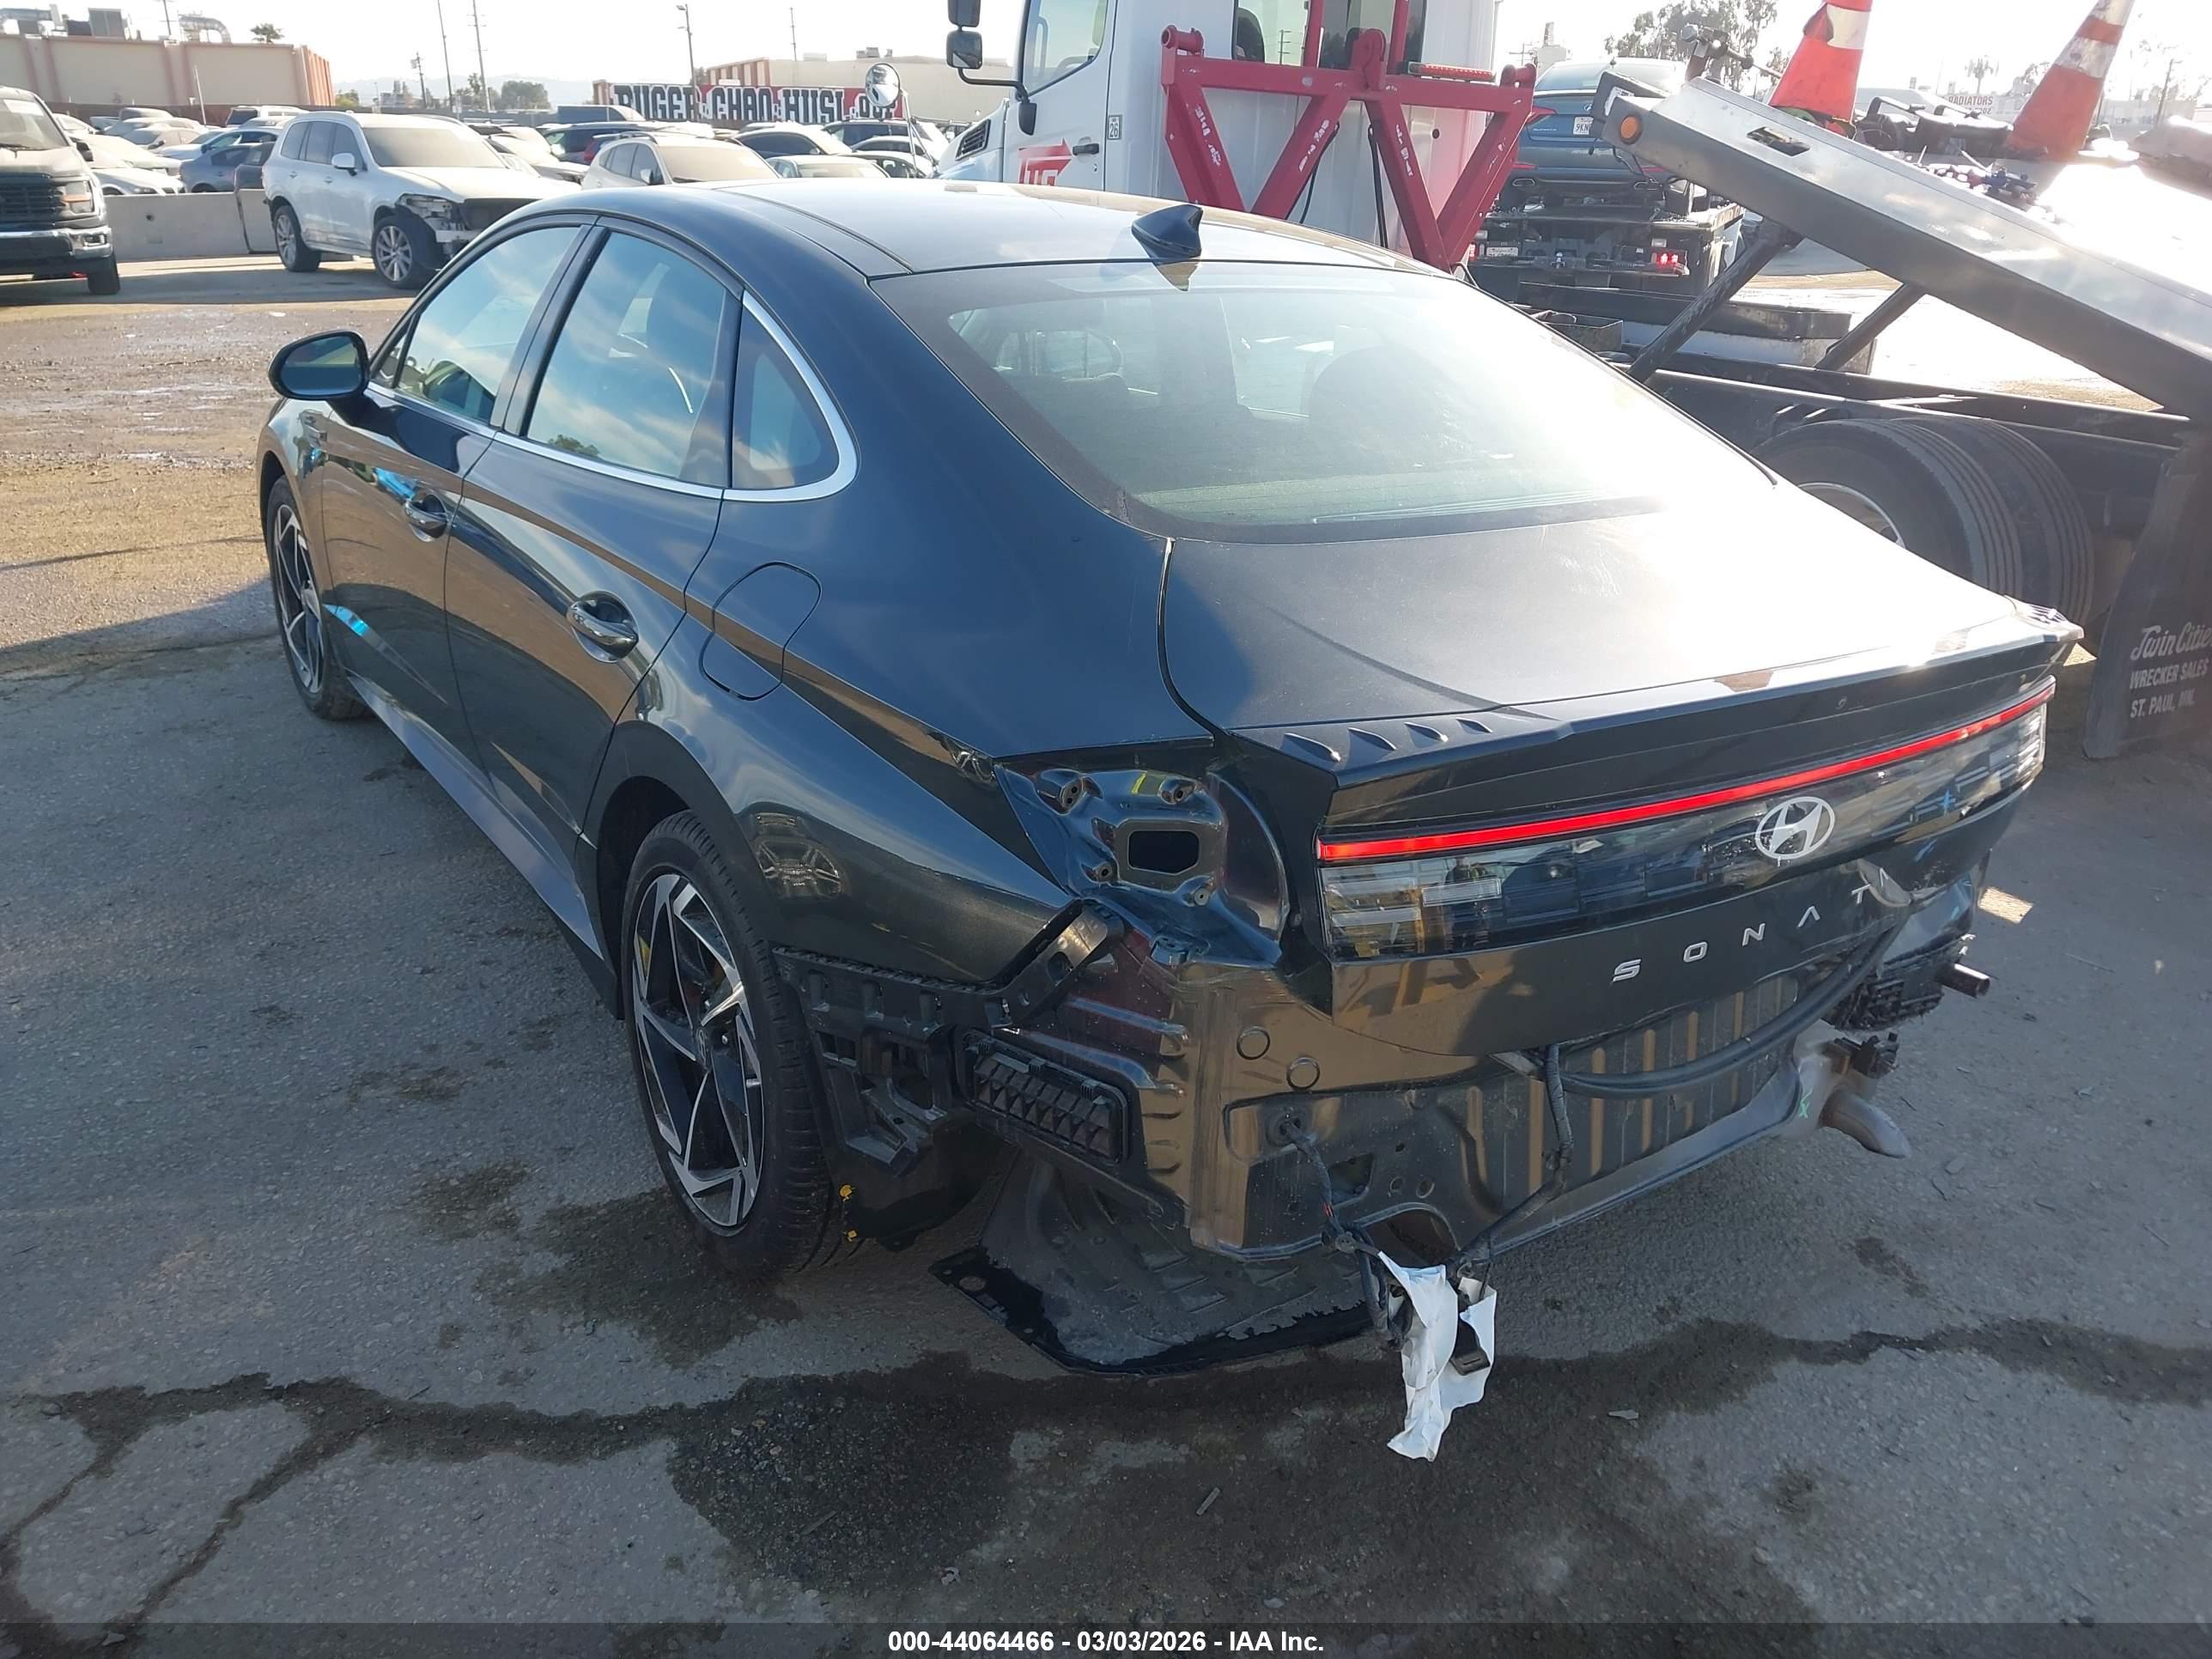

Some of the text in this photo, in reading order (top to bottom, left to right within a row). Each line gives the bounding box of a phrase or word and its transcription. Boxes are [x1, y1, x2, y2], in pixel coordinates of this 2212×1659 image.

[1109, 123, 1119, 137] 26
[2130, 624, 2177, 660] Twin
[2129, 658, 2209, 690] WRECKER SALES
